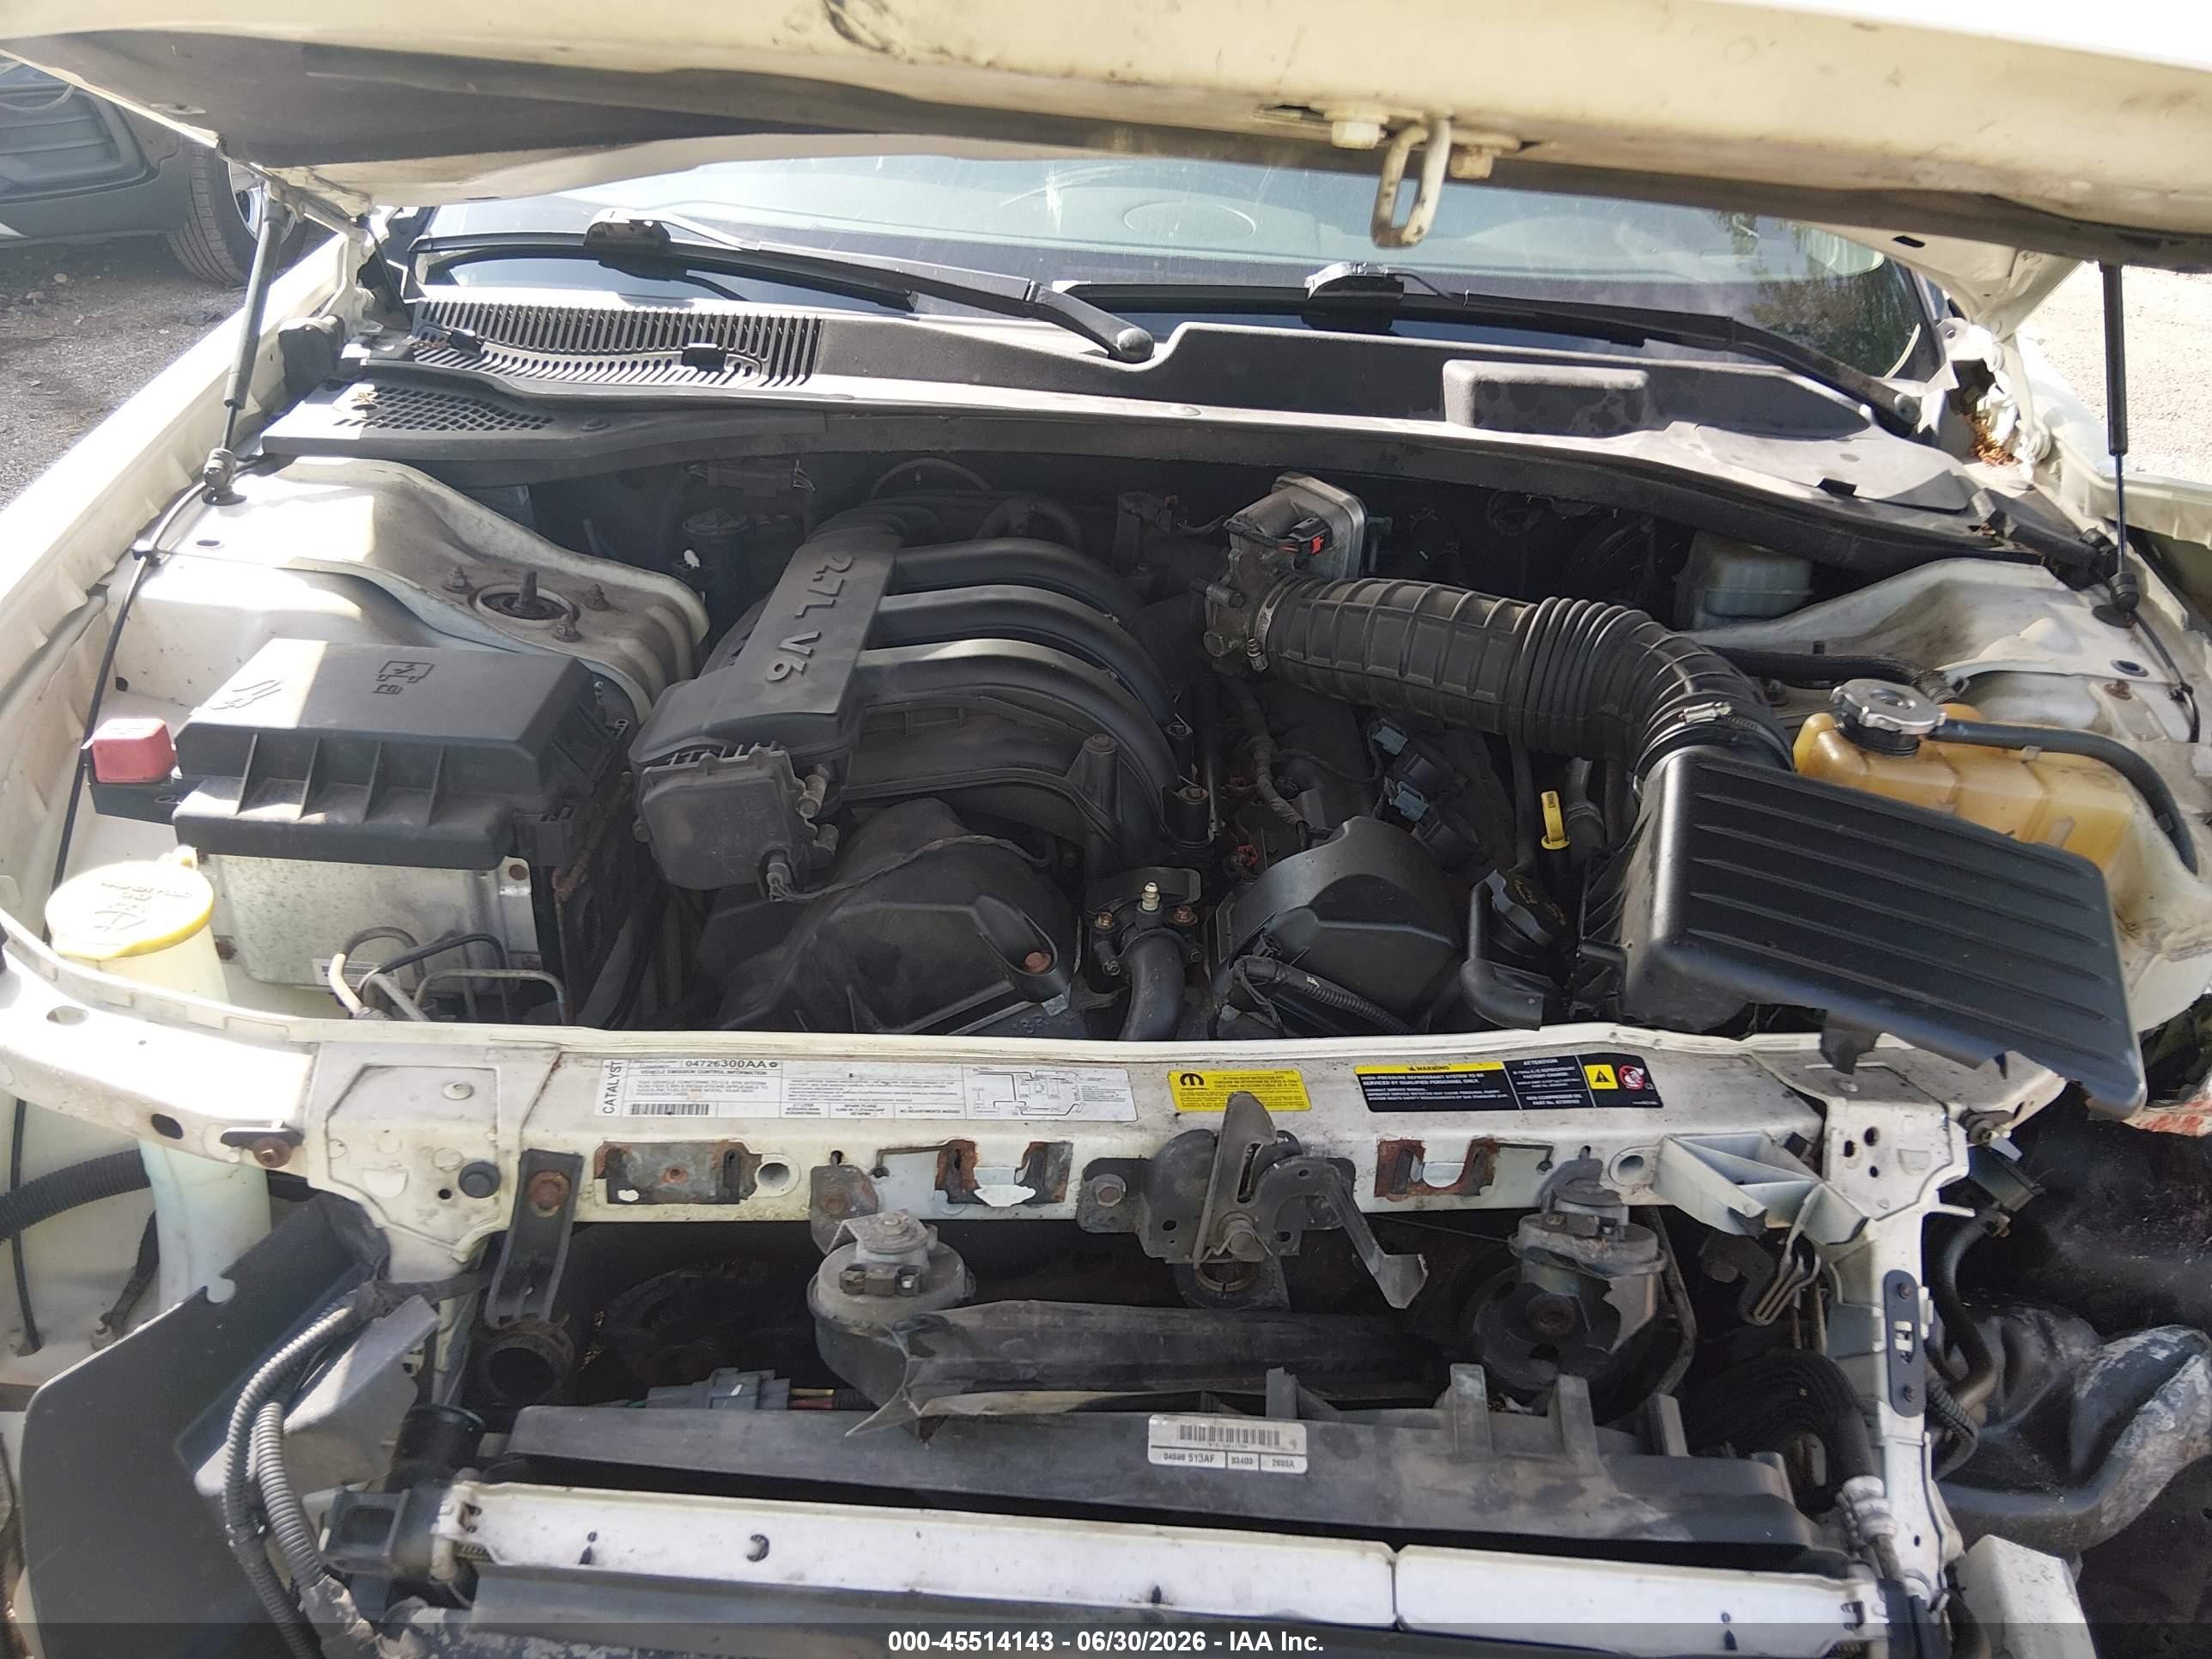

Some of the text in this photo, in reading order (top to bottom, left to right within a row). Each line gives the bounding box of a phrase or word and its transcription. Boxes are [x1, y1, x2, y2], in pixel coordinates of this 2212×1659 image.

[765, 556, 854, 683] 2.7L V6
[603, 1060, 623, 1115] CATALYST
[685, 1059, 768, 1068] 04726300AA
